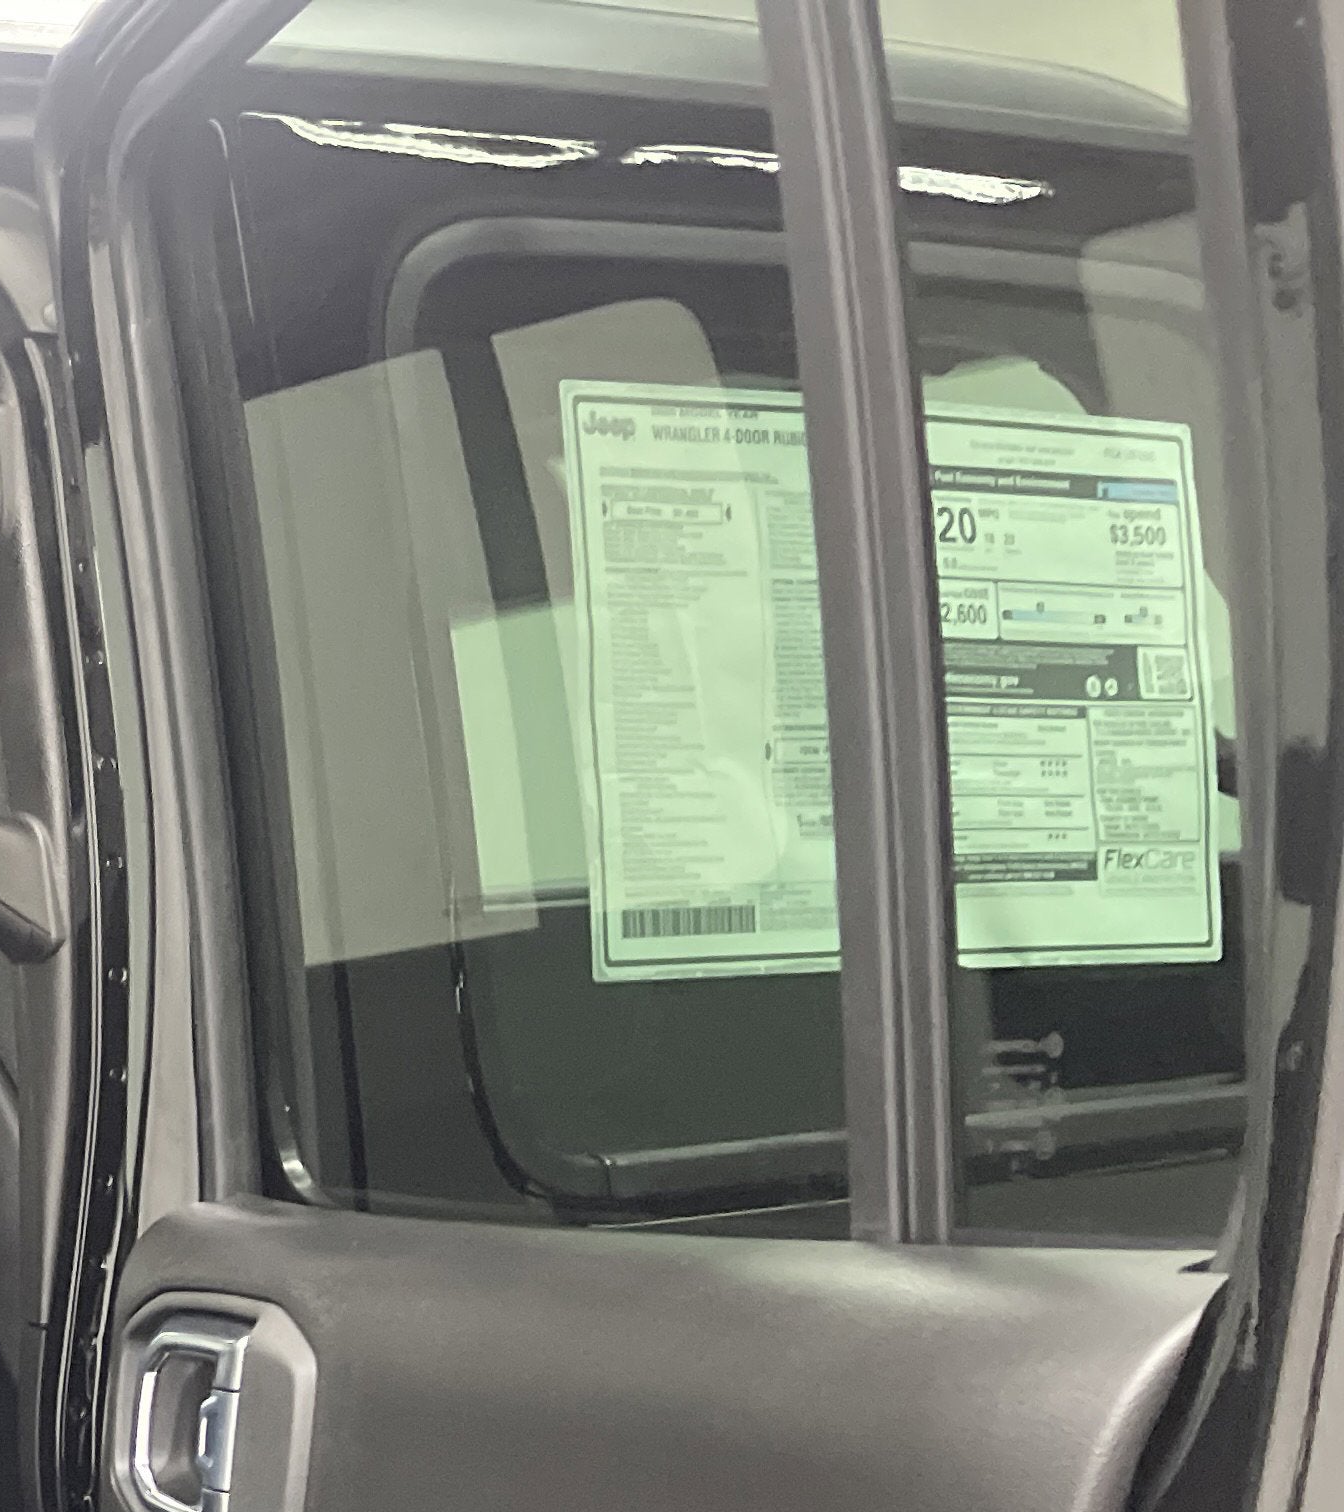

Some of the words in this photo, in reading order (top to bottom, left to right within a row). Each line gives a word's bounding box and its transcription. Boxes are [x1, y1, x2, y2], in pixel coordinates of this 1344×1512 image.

[582, 410, 636, 441] Jeep
[652, 425, 720, 443] WRANGLER
[937, 507, 977, 544] 20
[1109, 524, 1166, 546] $3,500
[1104, 848, 1195, 870] FlexCare
